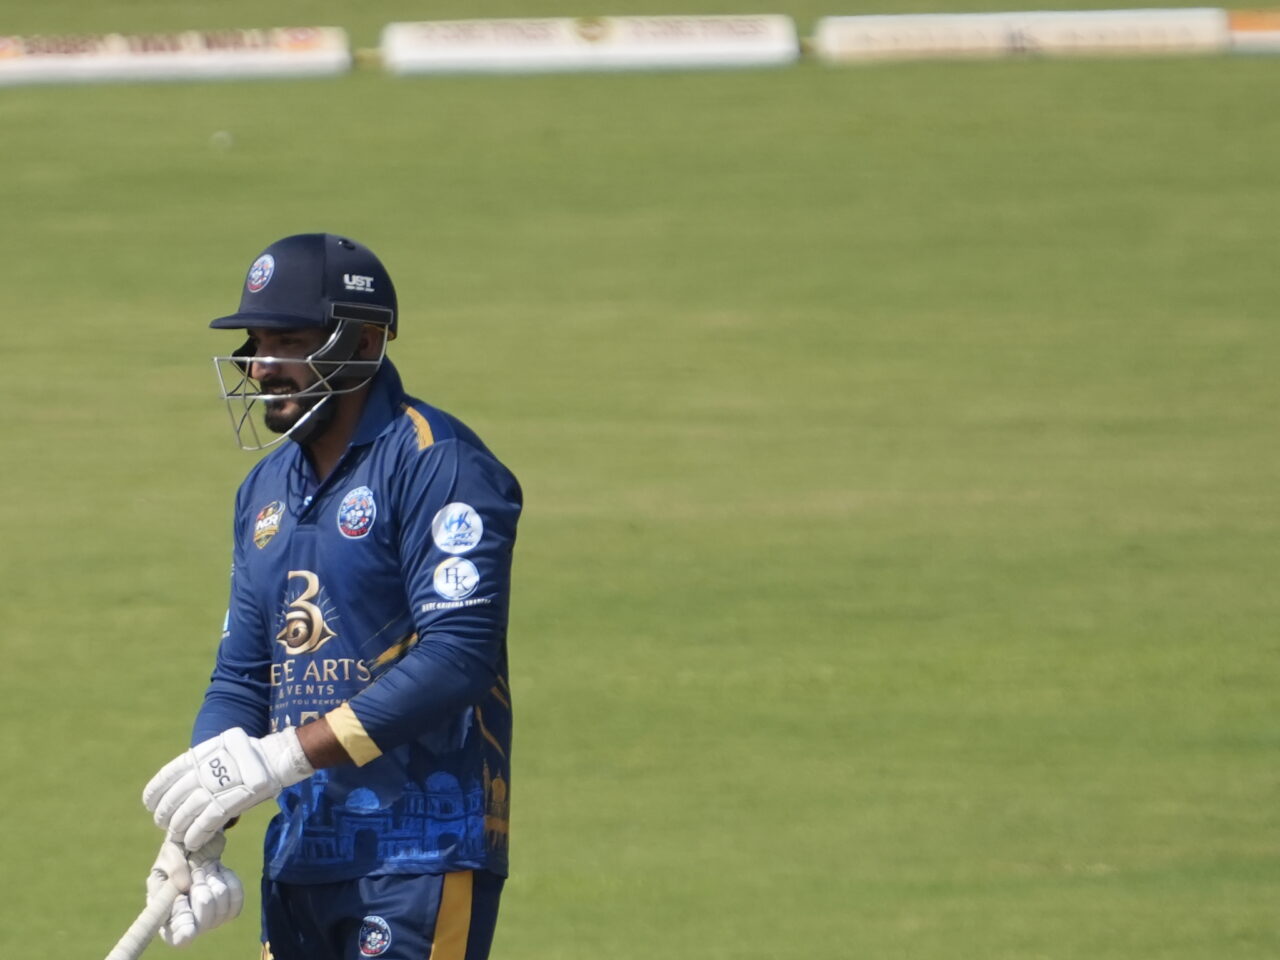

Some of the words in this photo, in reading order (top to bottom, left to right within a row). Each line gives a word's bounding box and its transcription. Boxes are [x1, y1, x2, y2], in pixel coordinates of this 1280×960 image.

[343, 273, 374, 288] UST
[445, 567, 469, 591] HK
[303, 658, 372, 682] ARTS
[208, 757, 231, 787] DSC
